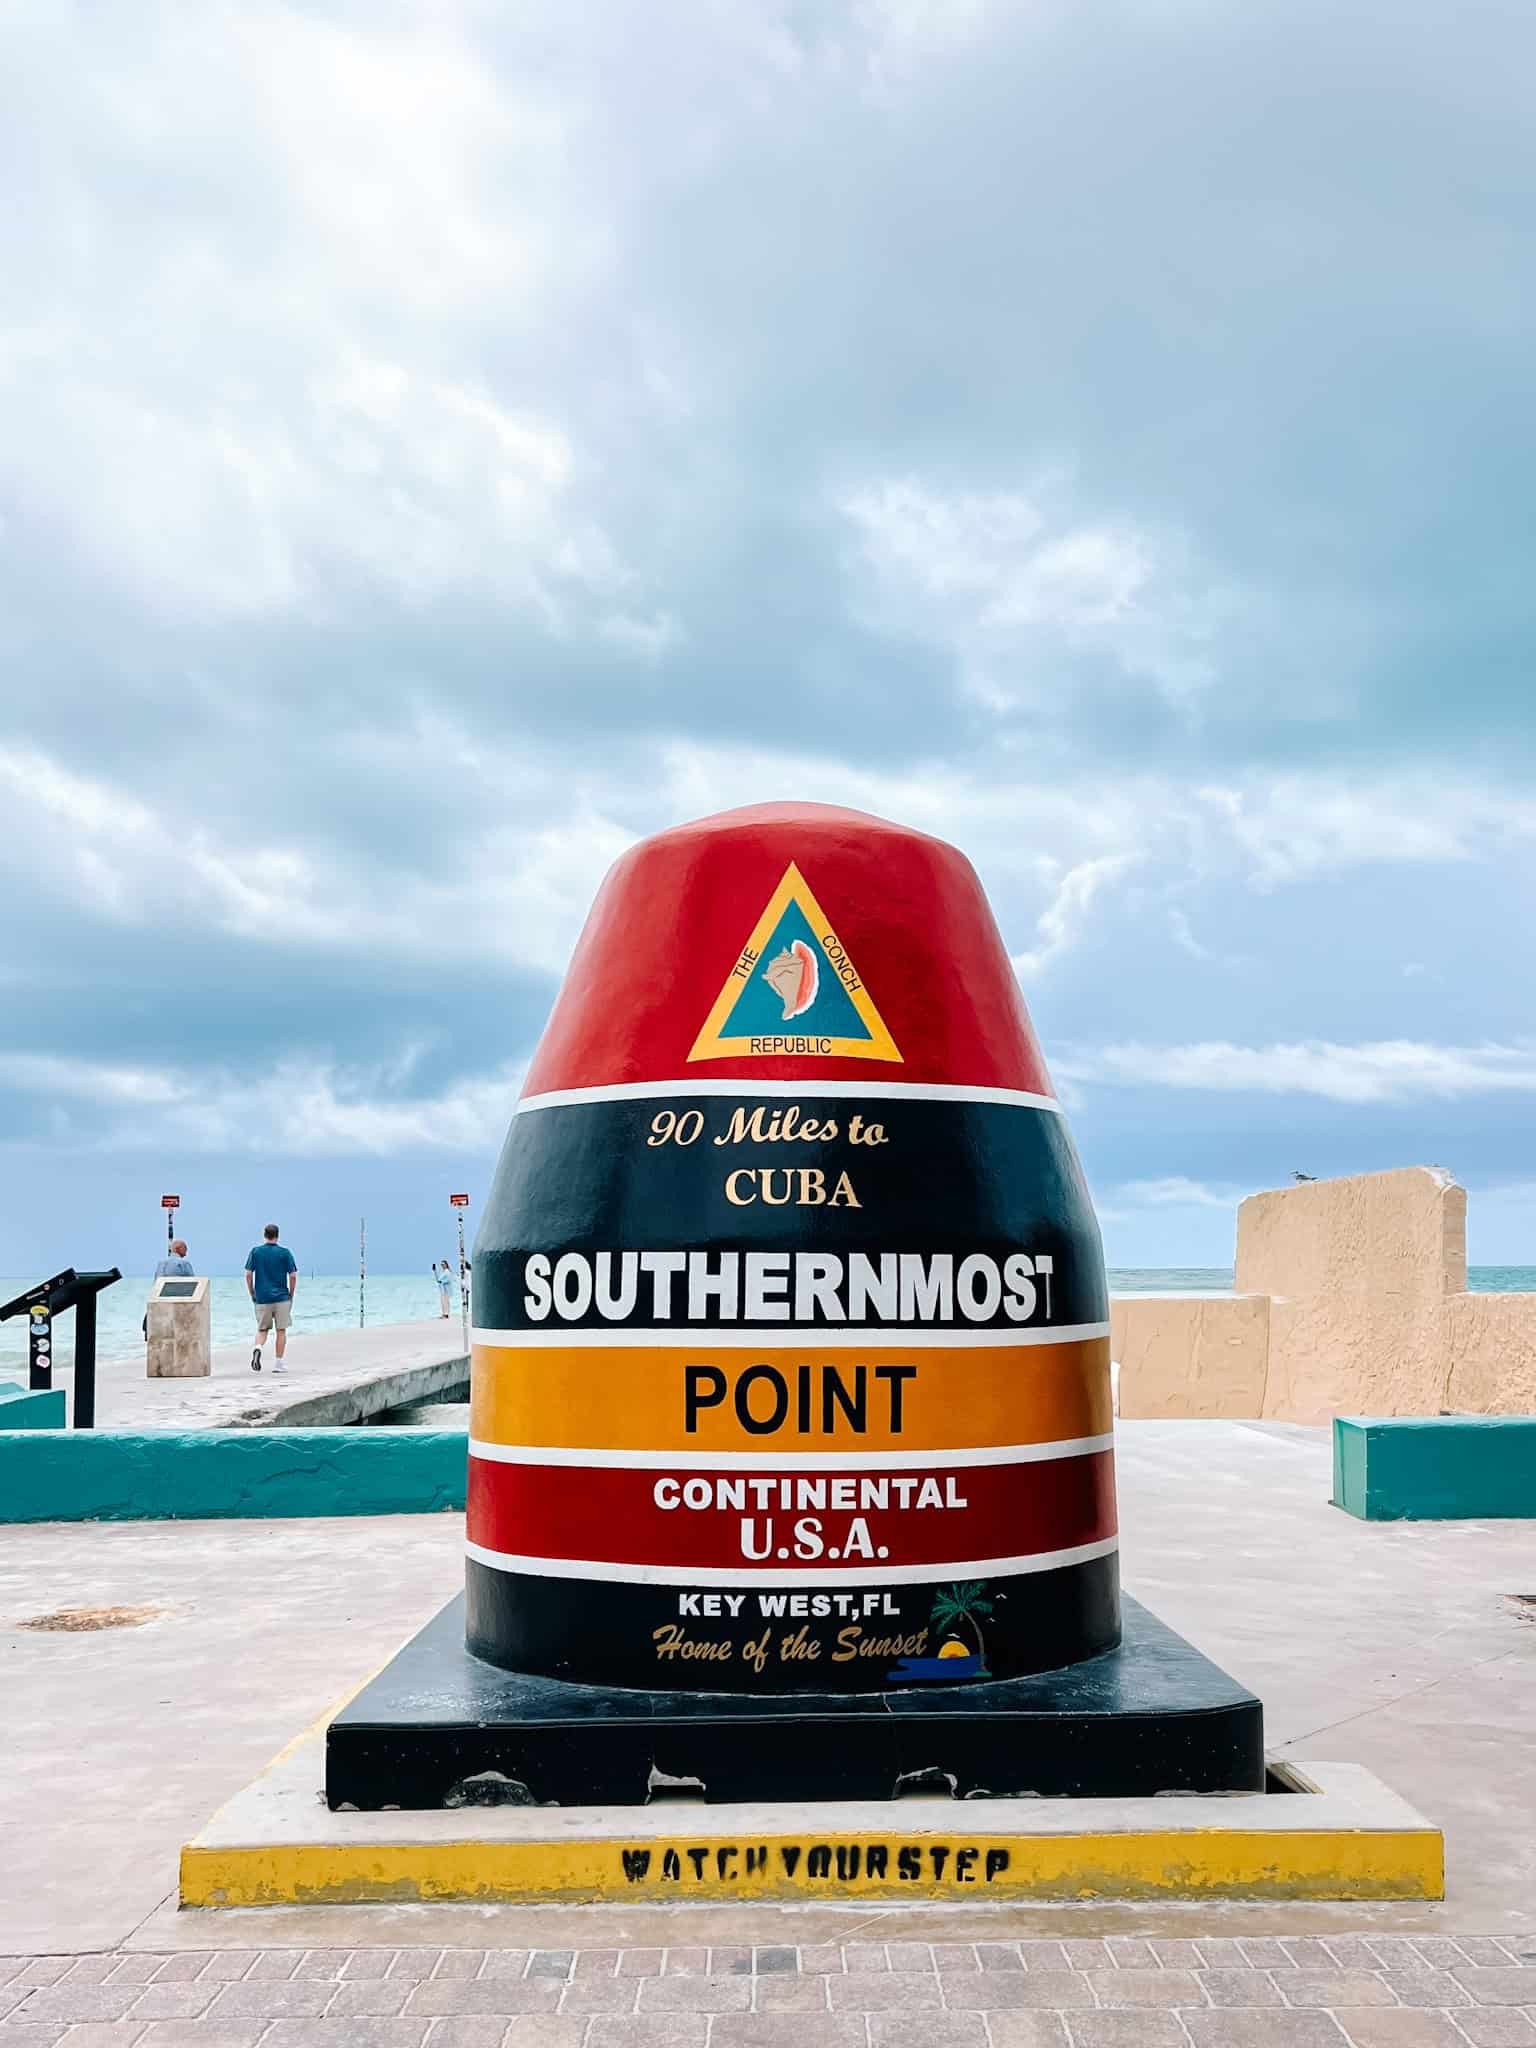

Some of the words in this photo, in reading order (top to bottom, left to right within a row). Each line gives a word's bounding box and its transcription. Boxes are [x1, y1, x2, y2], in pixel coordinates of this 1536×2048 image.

[732, 947, 759, 979] THE
[822, 935, 861, 992] CONCH
[750, 1037, 832, 1054] REPUBLIC
[647, 1110, 703, 1147] 90
[714, 1106, 839, 1147] Miles
[848, 1116, 889, 1147] to
[725, 1169, 863, 1208] CUBA
[524, 1251, 1053, 1322] SOUTHERNMOST
[685, 1365, 917, 1435] POINT
[653, 1477, 967, 1510] CONTINENTAL
[741, 1518, 889, 1560] U.S.A.
[678, 1594, 746, 1617] KEY
[652, 1625, 732, 1661] Home
[742, 1629, 772, 1673] of
[780, 1627, 822, 1660] the
[832, 1627, 928, 1661] Sunset
[621, 1846, 768, 1882] WATCH
[782, 1845, 888, 1880] YOUR
[898, 1847, 1009, 1882] STEP
